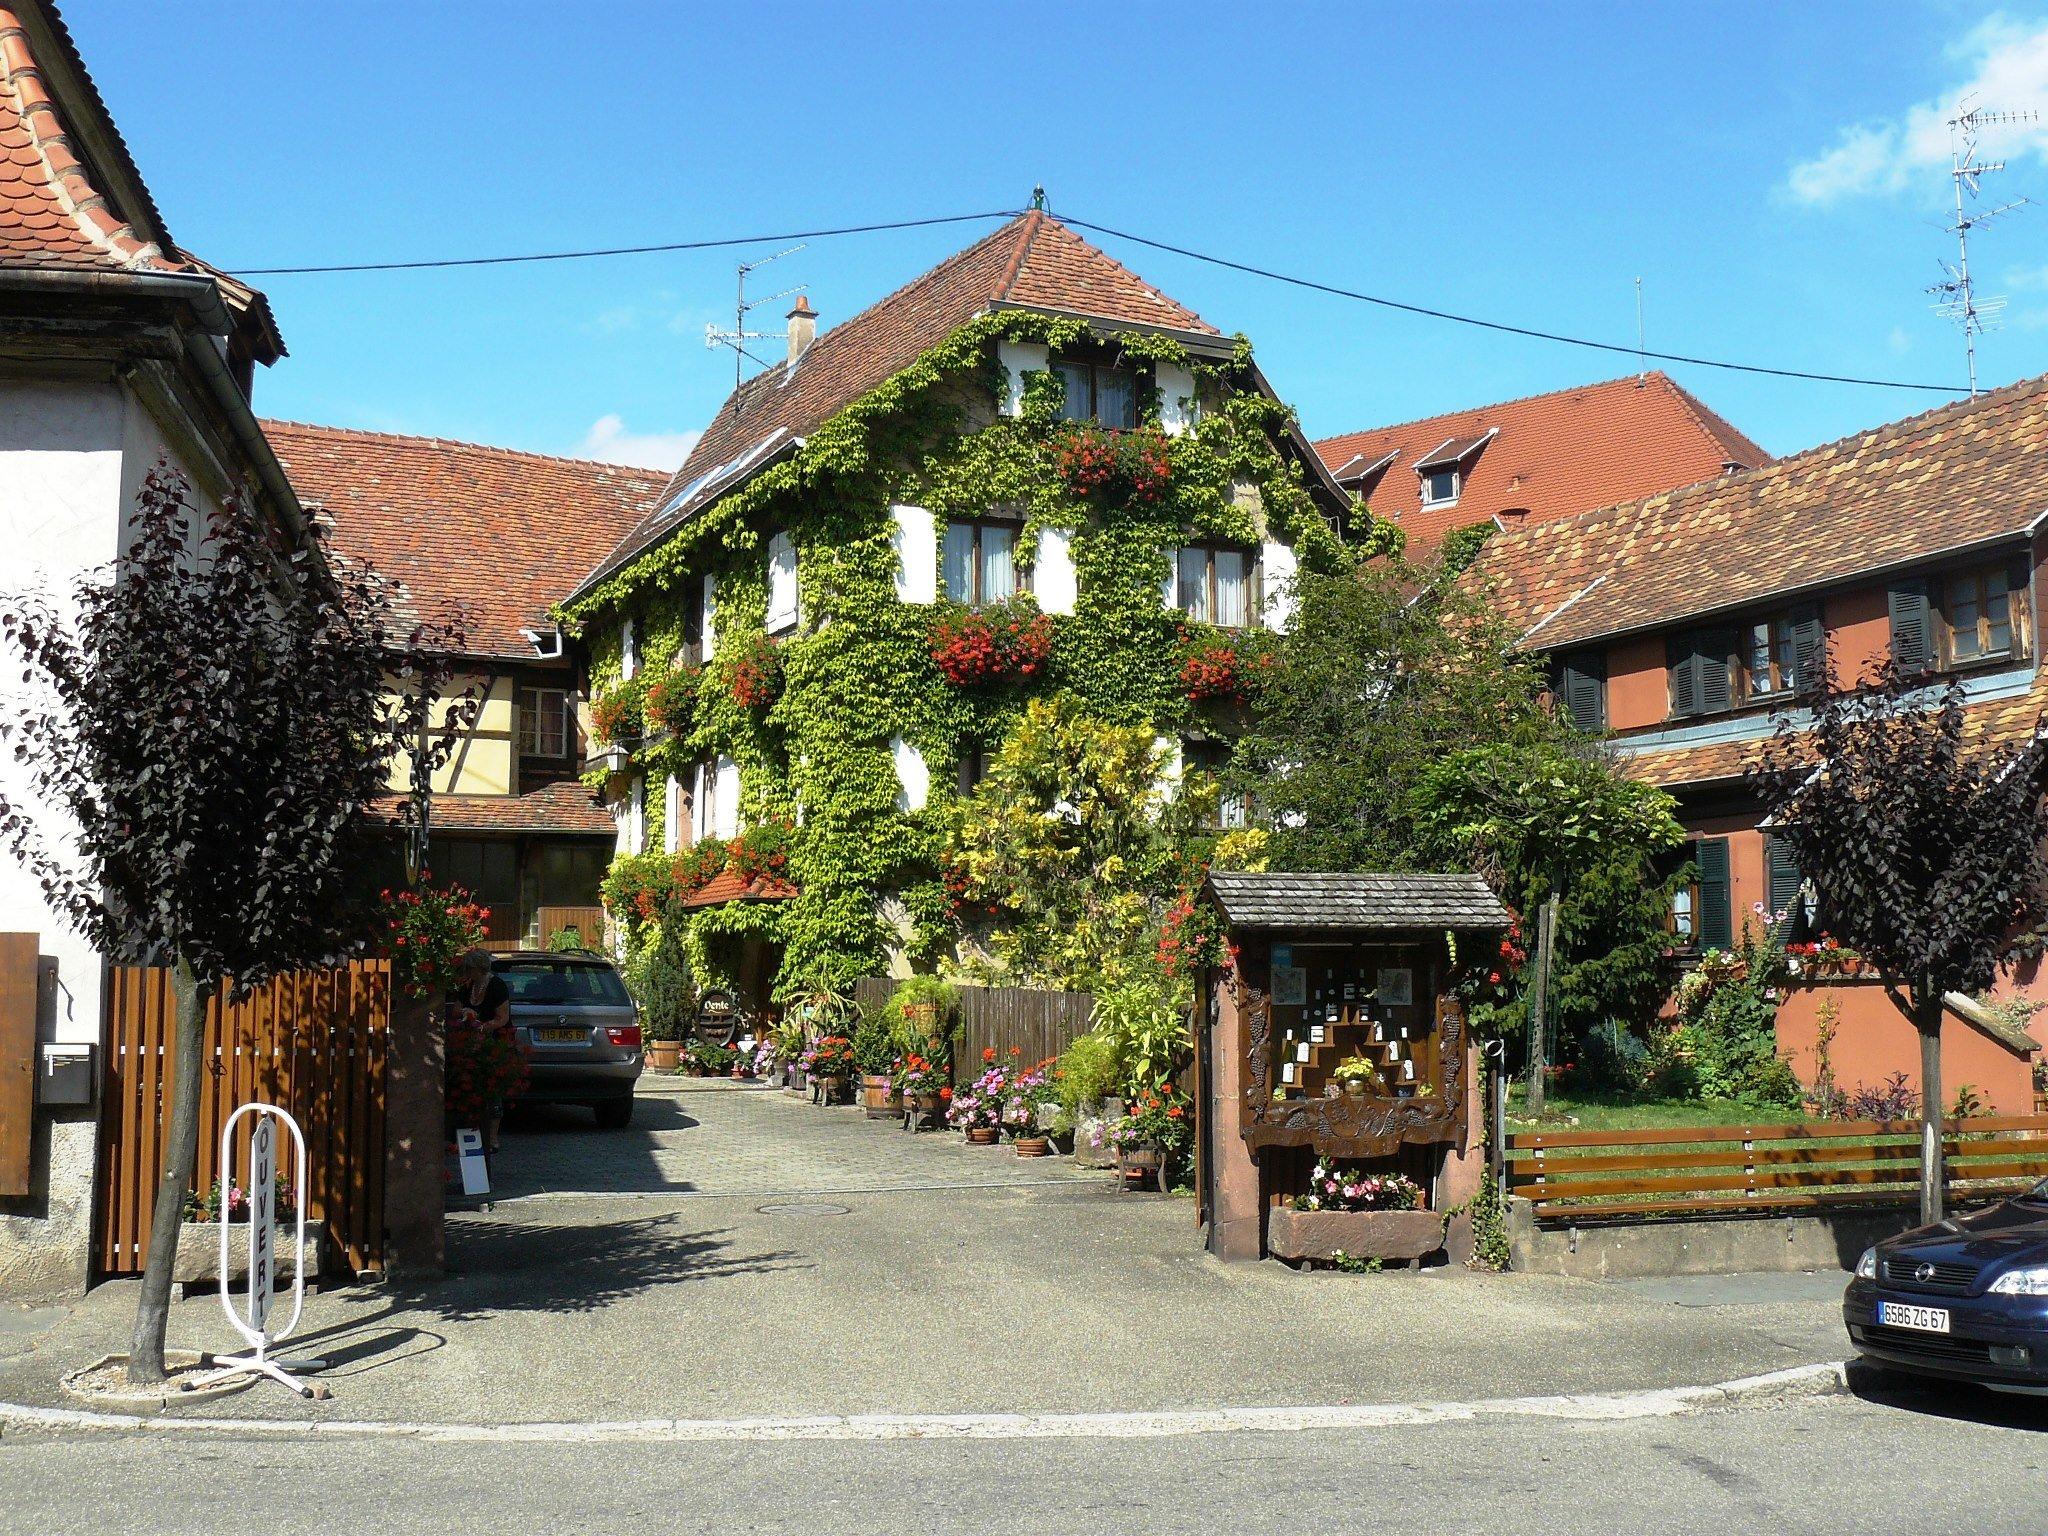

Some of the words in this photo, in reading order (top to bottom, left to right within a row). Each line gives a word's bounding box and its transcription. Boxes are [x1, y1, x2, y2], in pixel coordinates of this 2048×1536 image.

[576, 1030, 585, 1039] 67
[257, 1127, 268, 1318] OUVERT
[1885, 1304, 1911, 1325] 6586
[1913, 1308, 1928, 1327] ZG
[1931, 1310, 1946, 1330] 67
